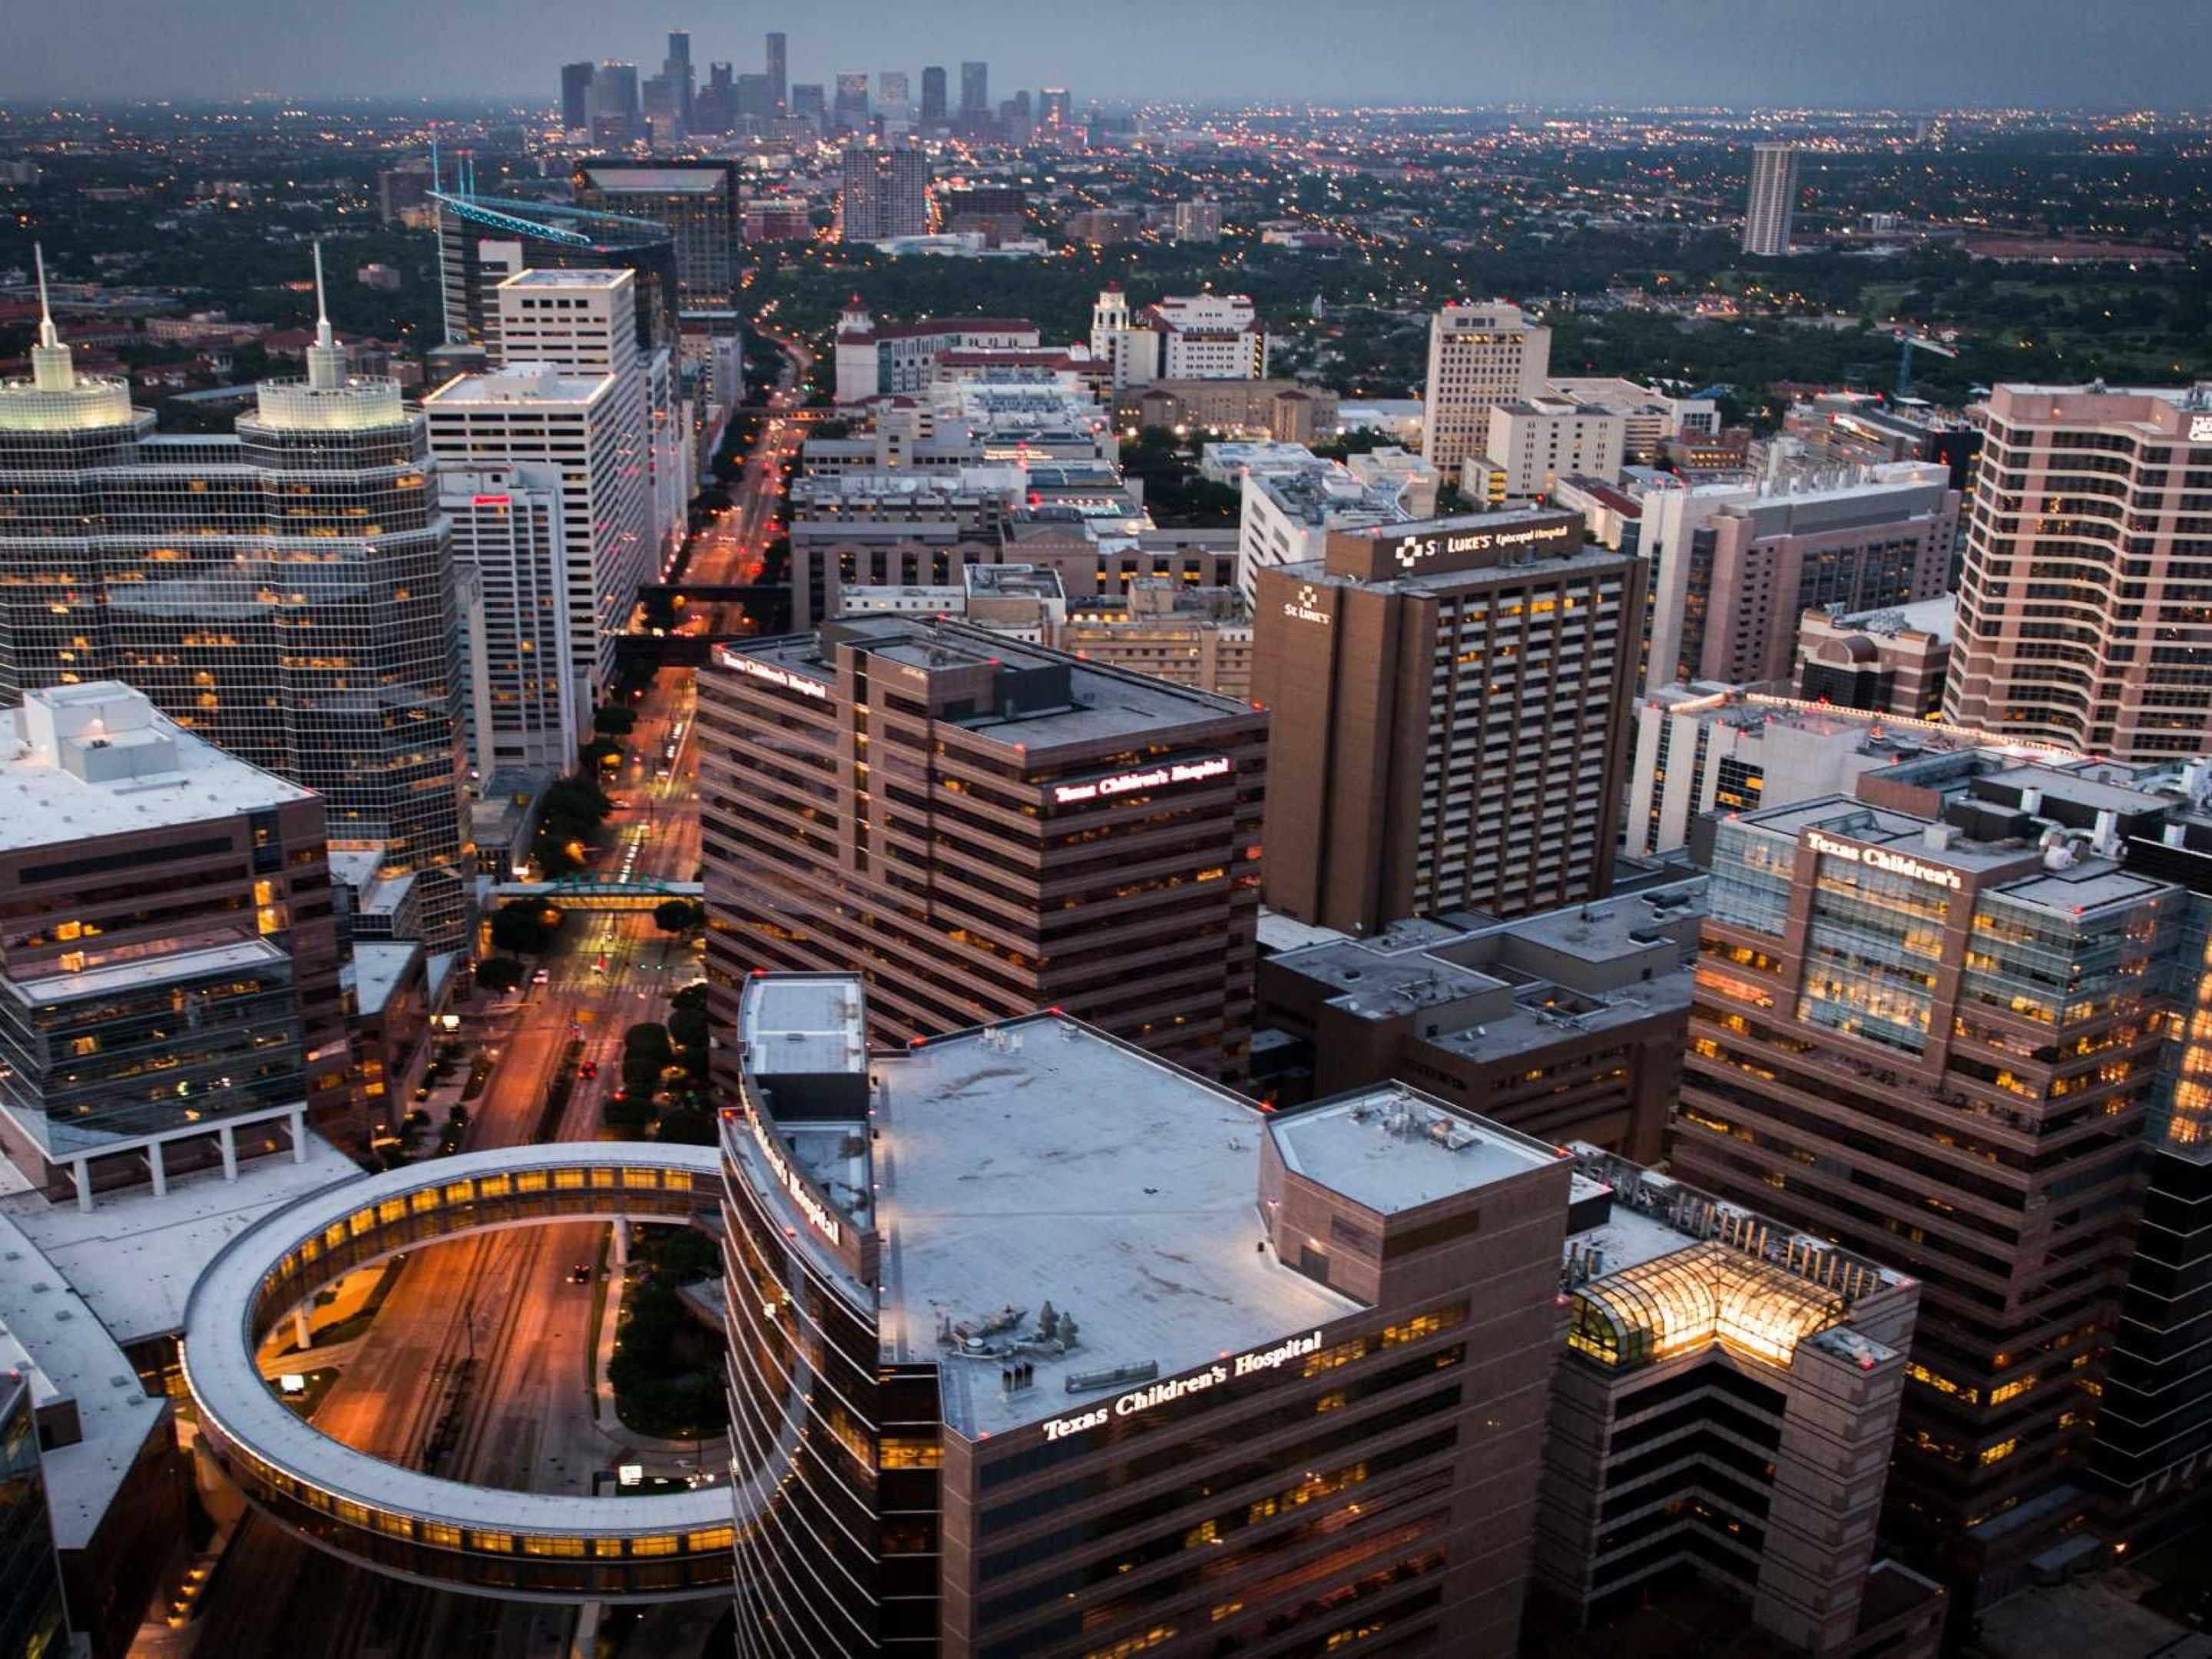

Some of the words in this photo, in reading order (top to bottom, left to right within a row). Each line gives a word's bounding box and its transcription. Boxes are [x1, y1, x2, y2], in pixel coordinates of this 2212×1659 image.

[1807, 832, 1859, 862] Texas
[1862, 848, 1962, 889] Children's
[1042, 1408, 1108, 1441] Texas
[1114, 1366, 1229, 1416] Children's
[1234, 1331, 1323, 1377] Hospital
